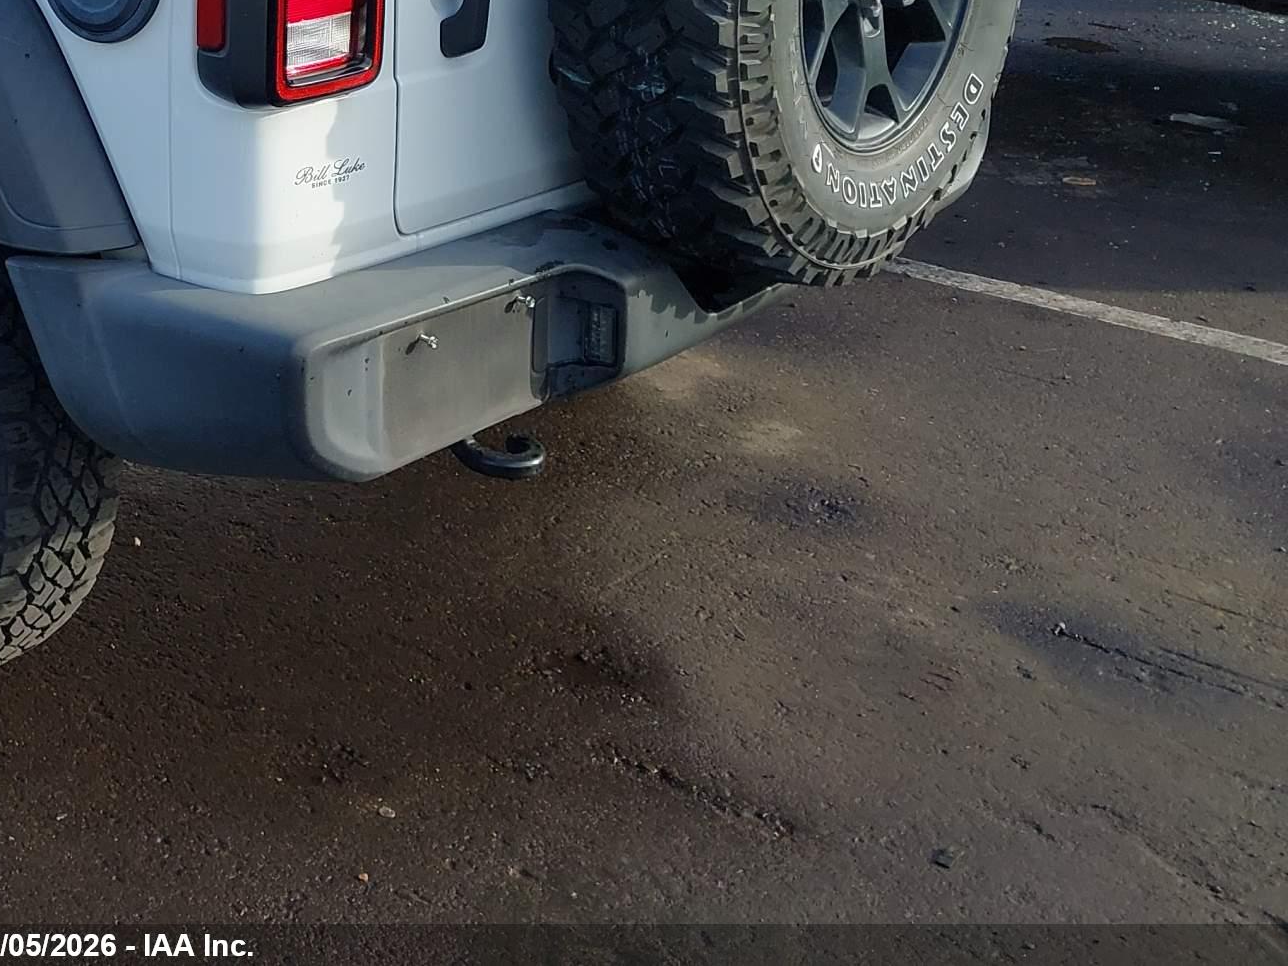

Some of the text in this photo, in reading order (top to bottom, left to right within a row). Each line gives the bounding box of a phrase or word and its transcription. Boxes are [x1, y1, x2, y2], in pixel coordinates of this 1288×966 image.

[825, 72, 985, 209] DESTINATION
[294, 157, 366, 186] Bill Luke
[311, 178, 332, 189] SINCE
